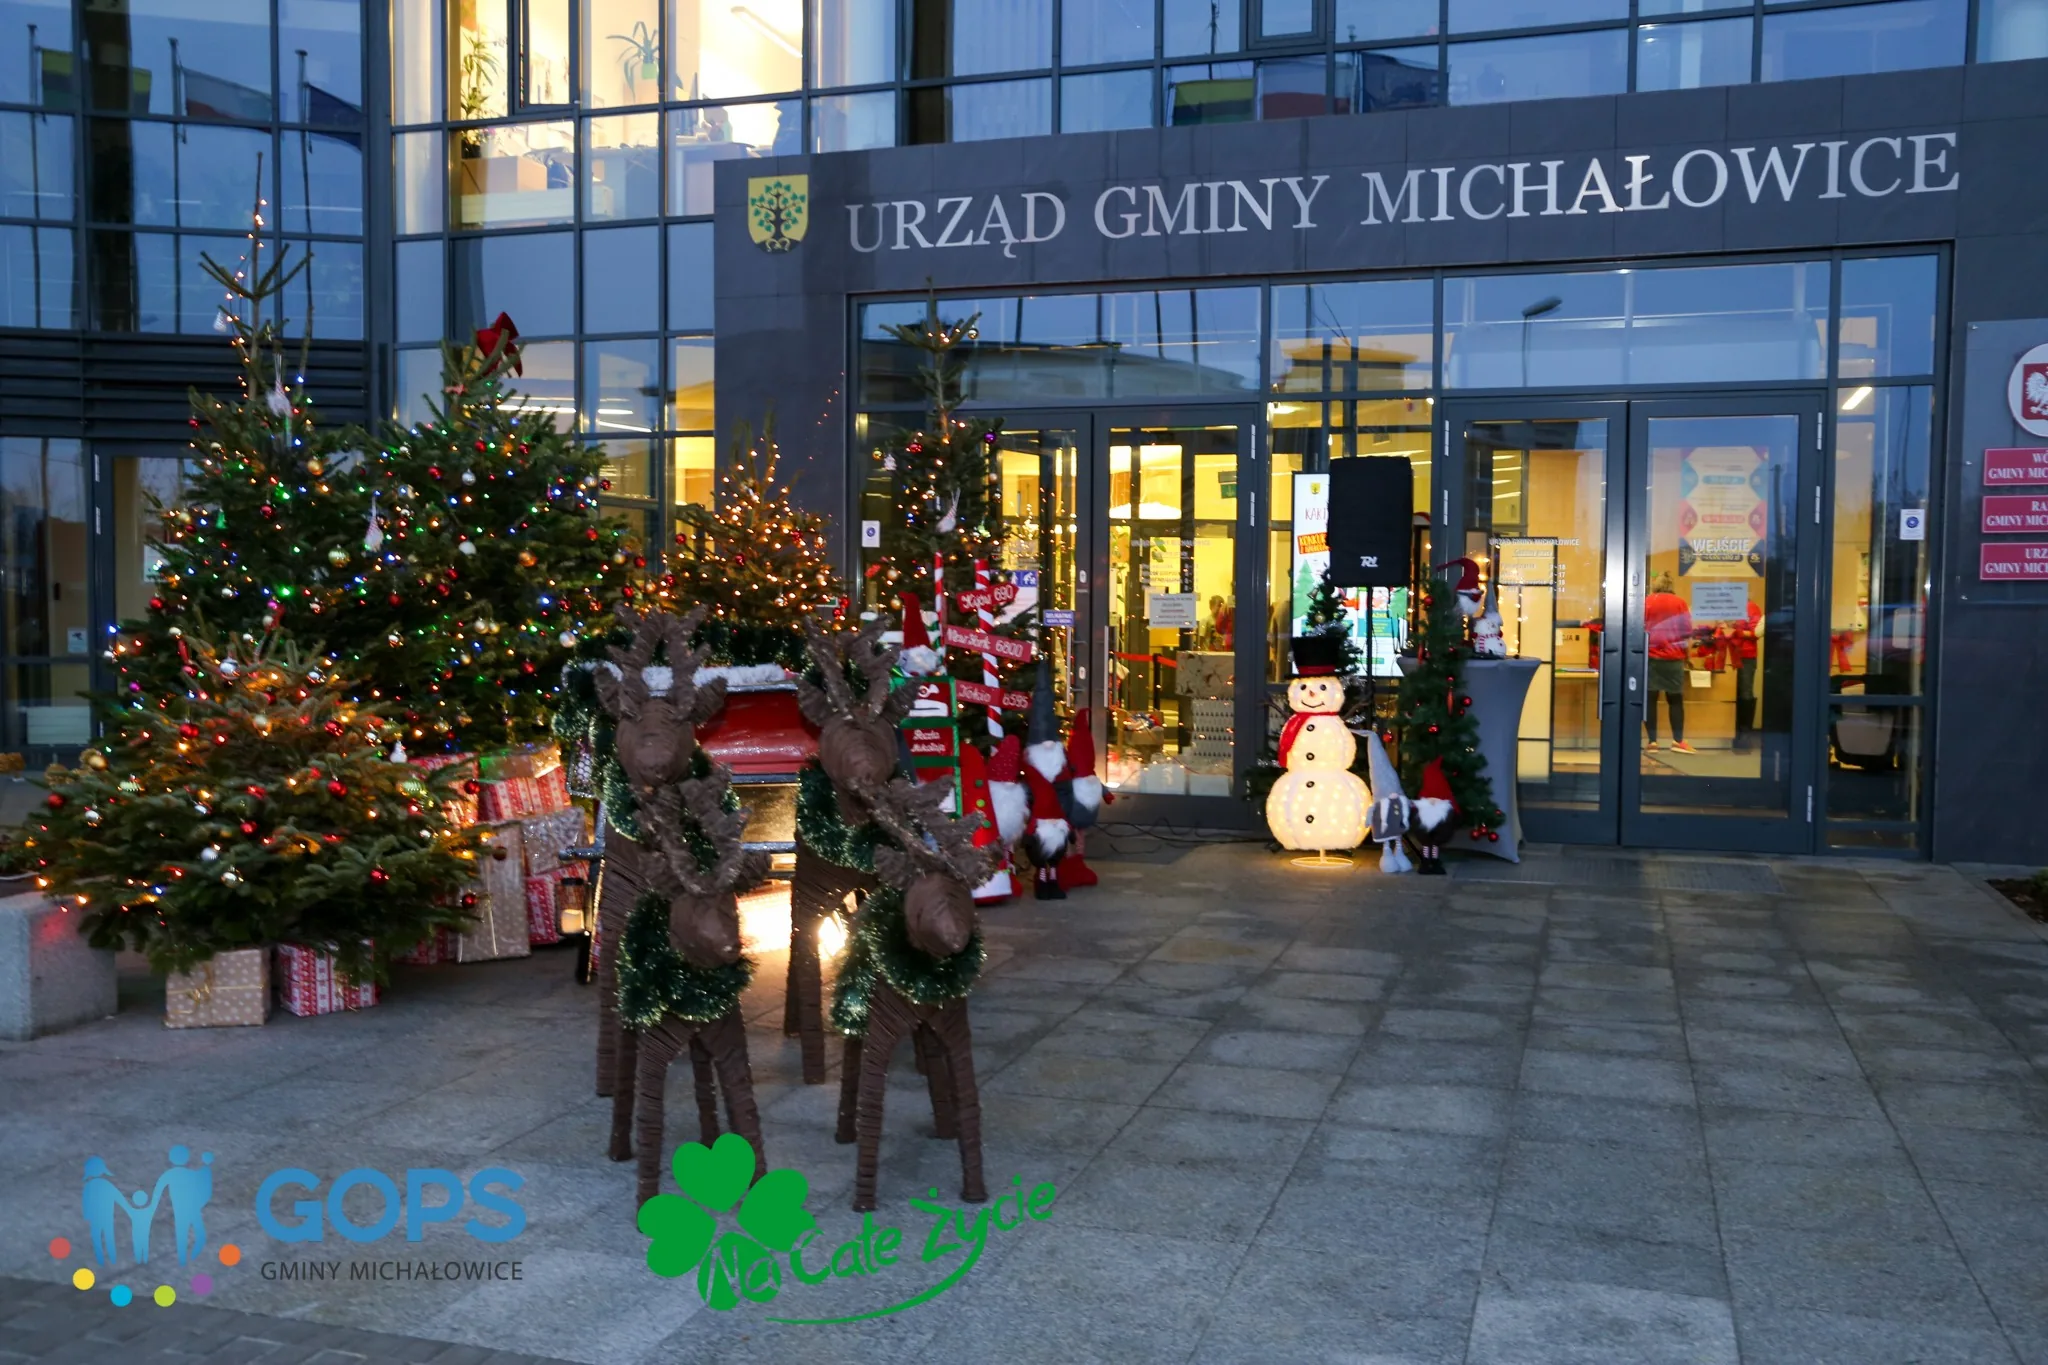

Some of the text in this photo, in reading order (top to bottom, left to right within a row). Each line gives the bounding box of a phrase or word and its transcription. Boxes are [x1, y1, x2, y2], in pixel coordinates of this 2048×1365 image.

[846, 132, 1960, 259] URZĄD GMINY MICHAŁOWICE
[1988, 467, 2025, 479] GMINY
[1986, 515, 2022, 526] GMINY
[1693, 536, 1752, 553] WEJŚCIE
[1985, 562, 2020, 574] GMINY
[993, 584, 1014, 602] 690
[995, 639, 1024, 658] 6800
